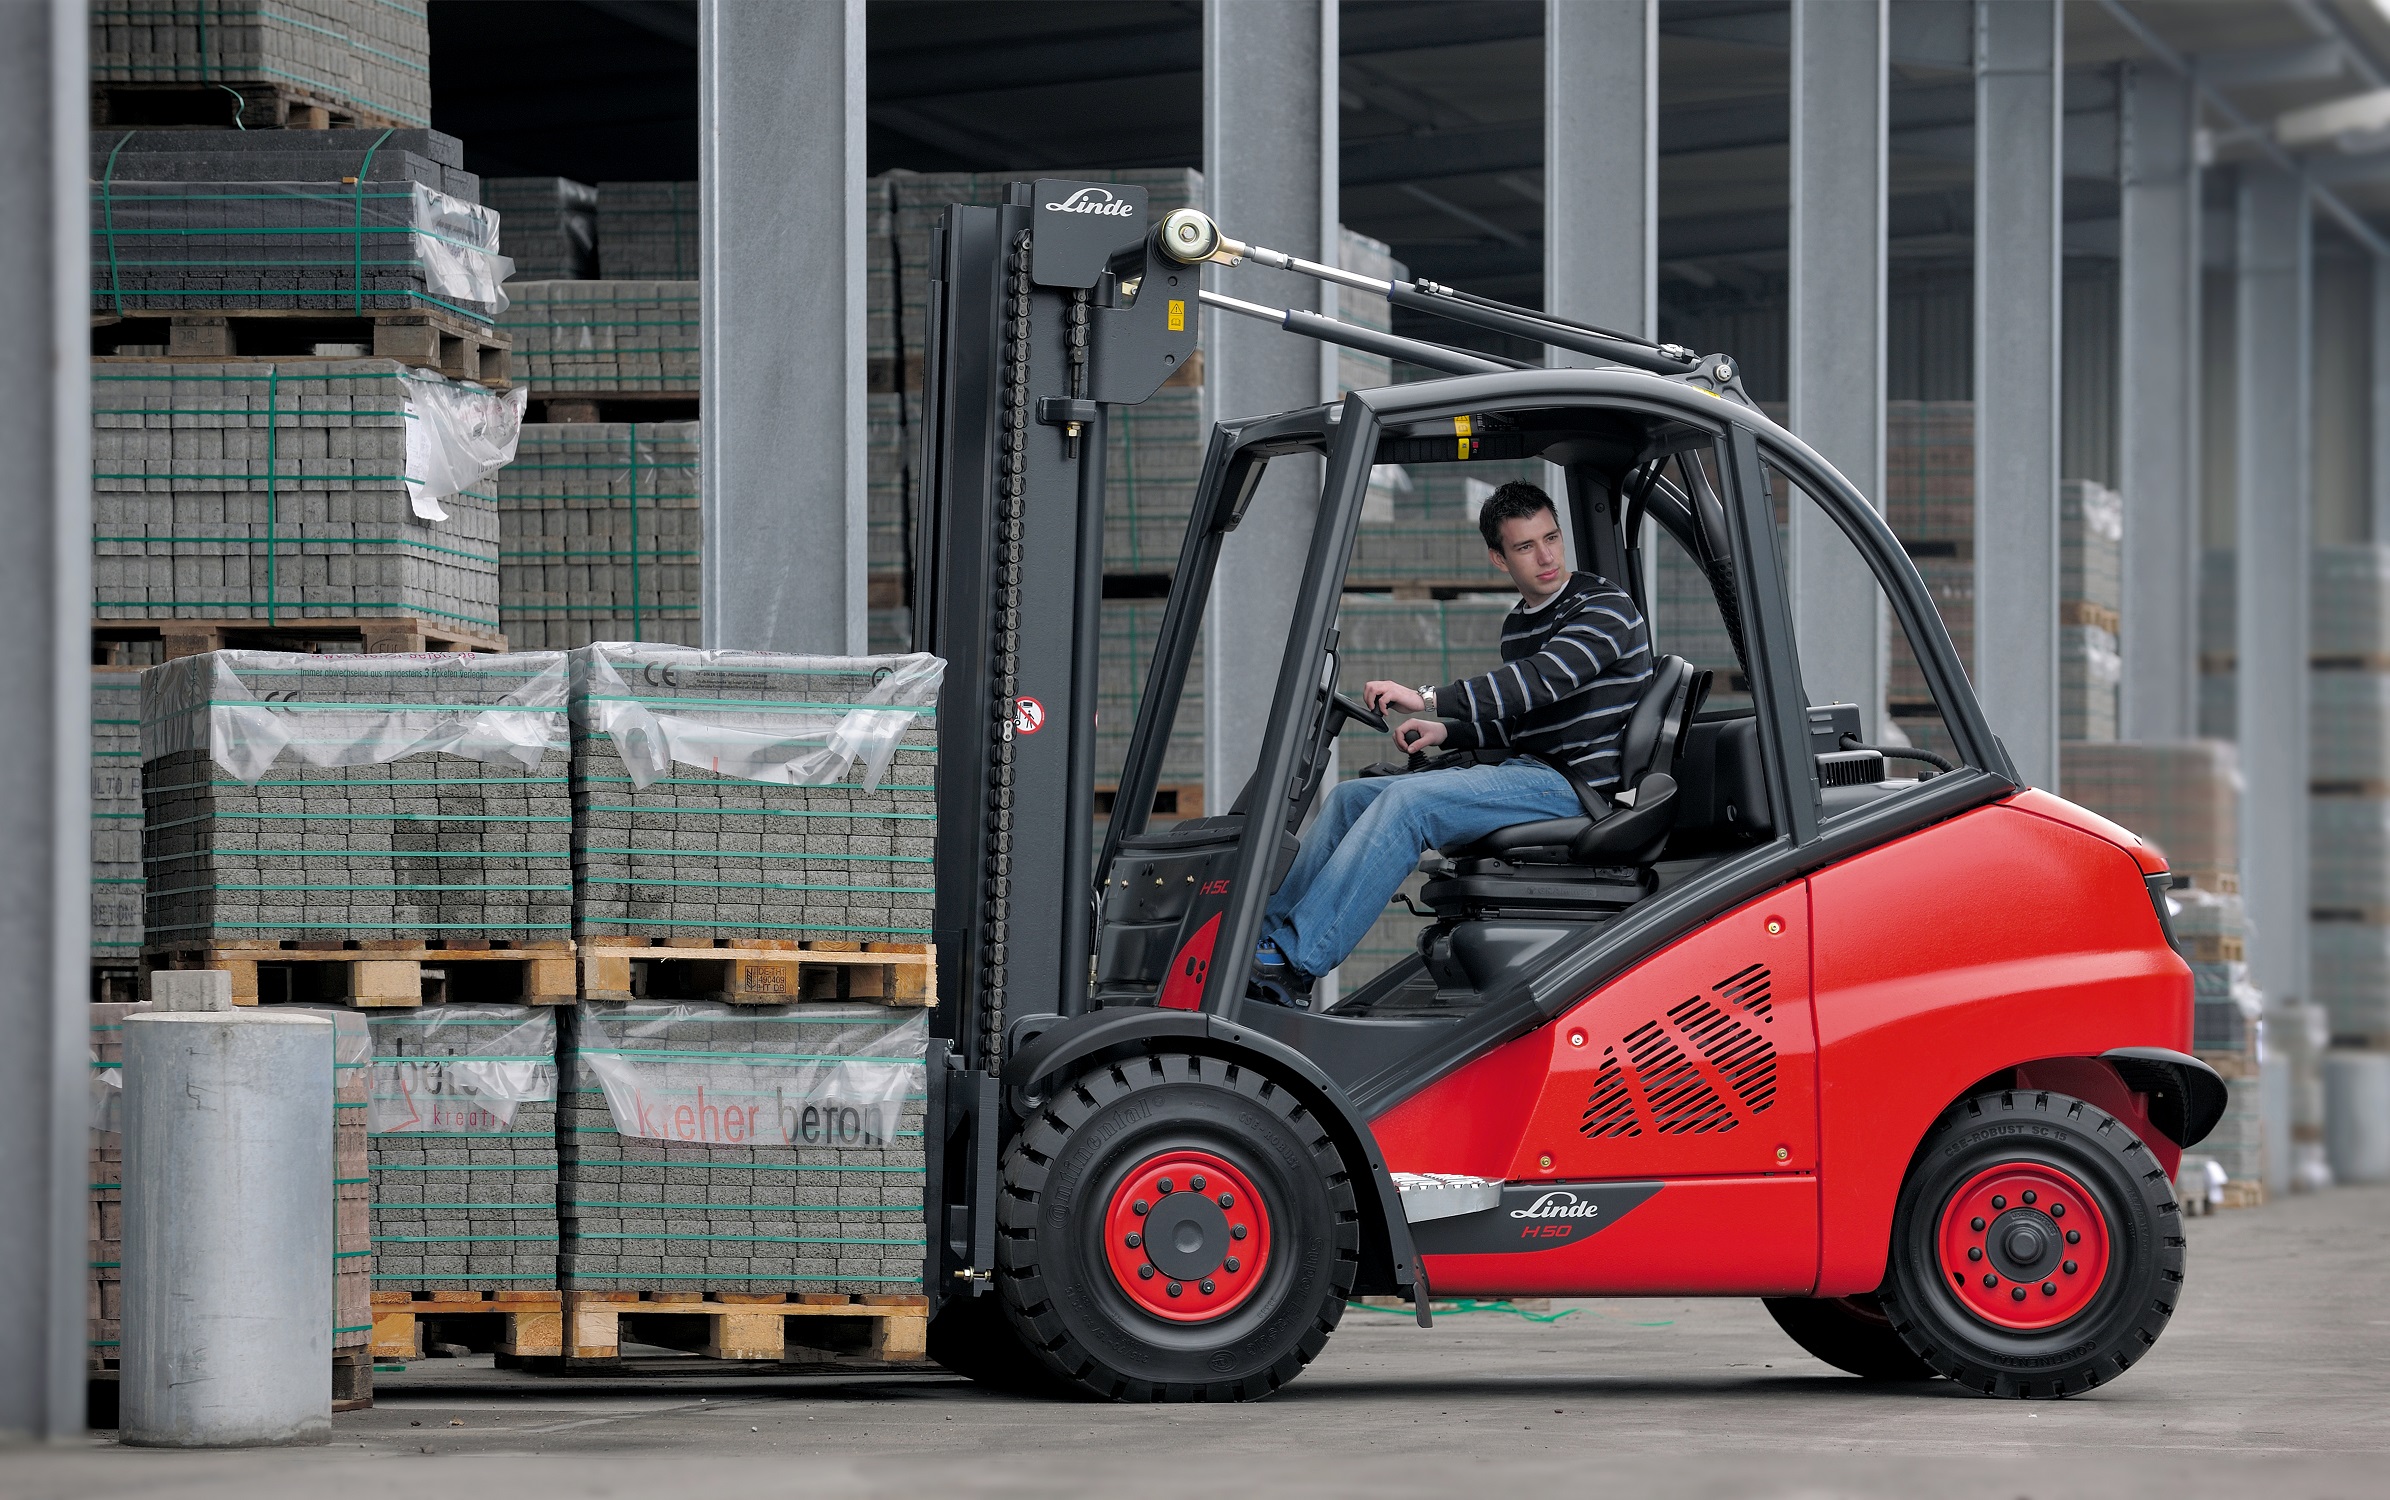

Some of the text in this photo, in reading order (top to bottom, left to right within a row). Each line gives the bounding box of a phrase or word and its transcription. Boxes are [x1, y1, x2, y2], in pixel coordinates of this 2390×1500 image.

[1045, 187, 1133, 217] Linde
[300, 668, 322, 678] Immer
[324, 669, 369, 678] abwechselnd
[384, 669, 423, 678] mindestens
[424, 668, 430, 678] 3
[431, 669, 458, 678] Paketen
[459, 670, 488, 682] verlegen
[644, 660, 677, 687] CE
[1944, 1124, 2068, 1157] CSE-ROBUST SC 15
[1046, 1096, 1153, 1229] Continental
[1509, 1191, 1599, 1219] Linde
[1988, 1339, 2097, 1369] CONTINENTAL
